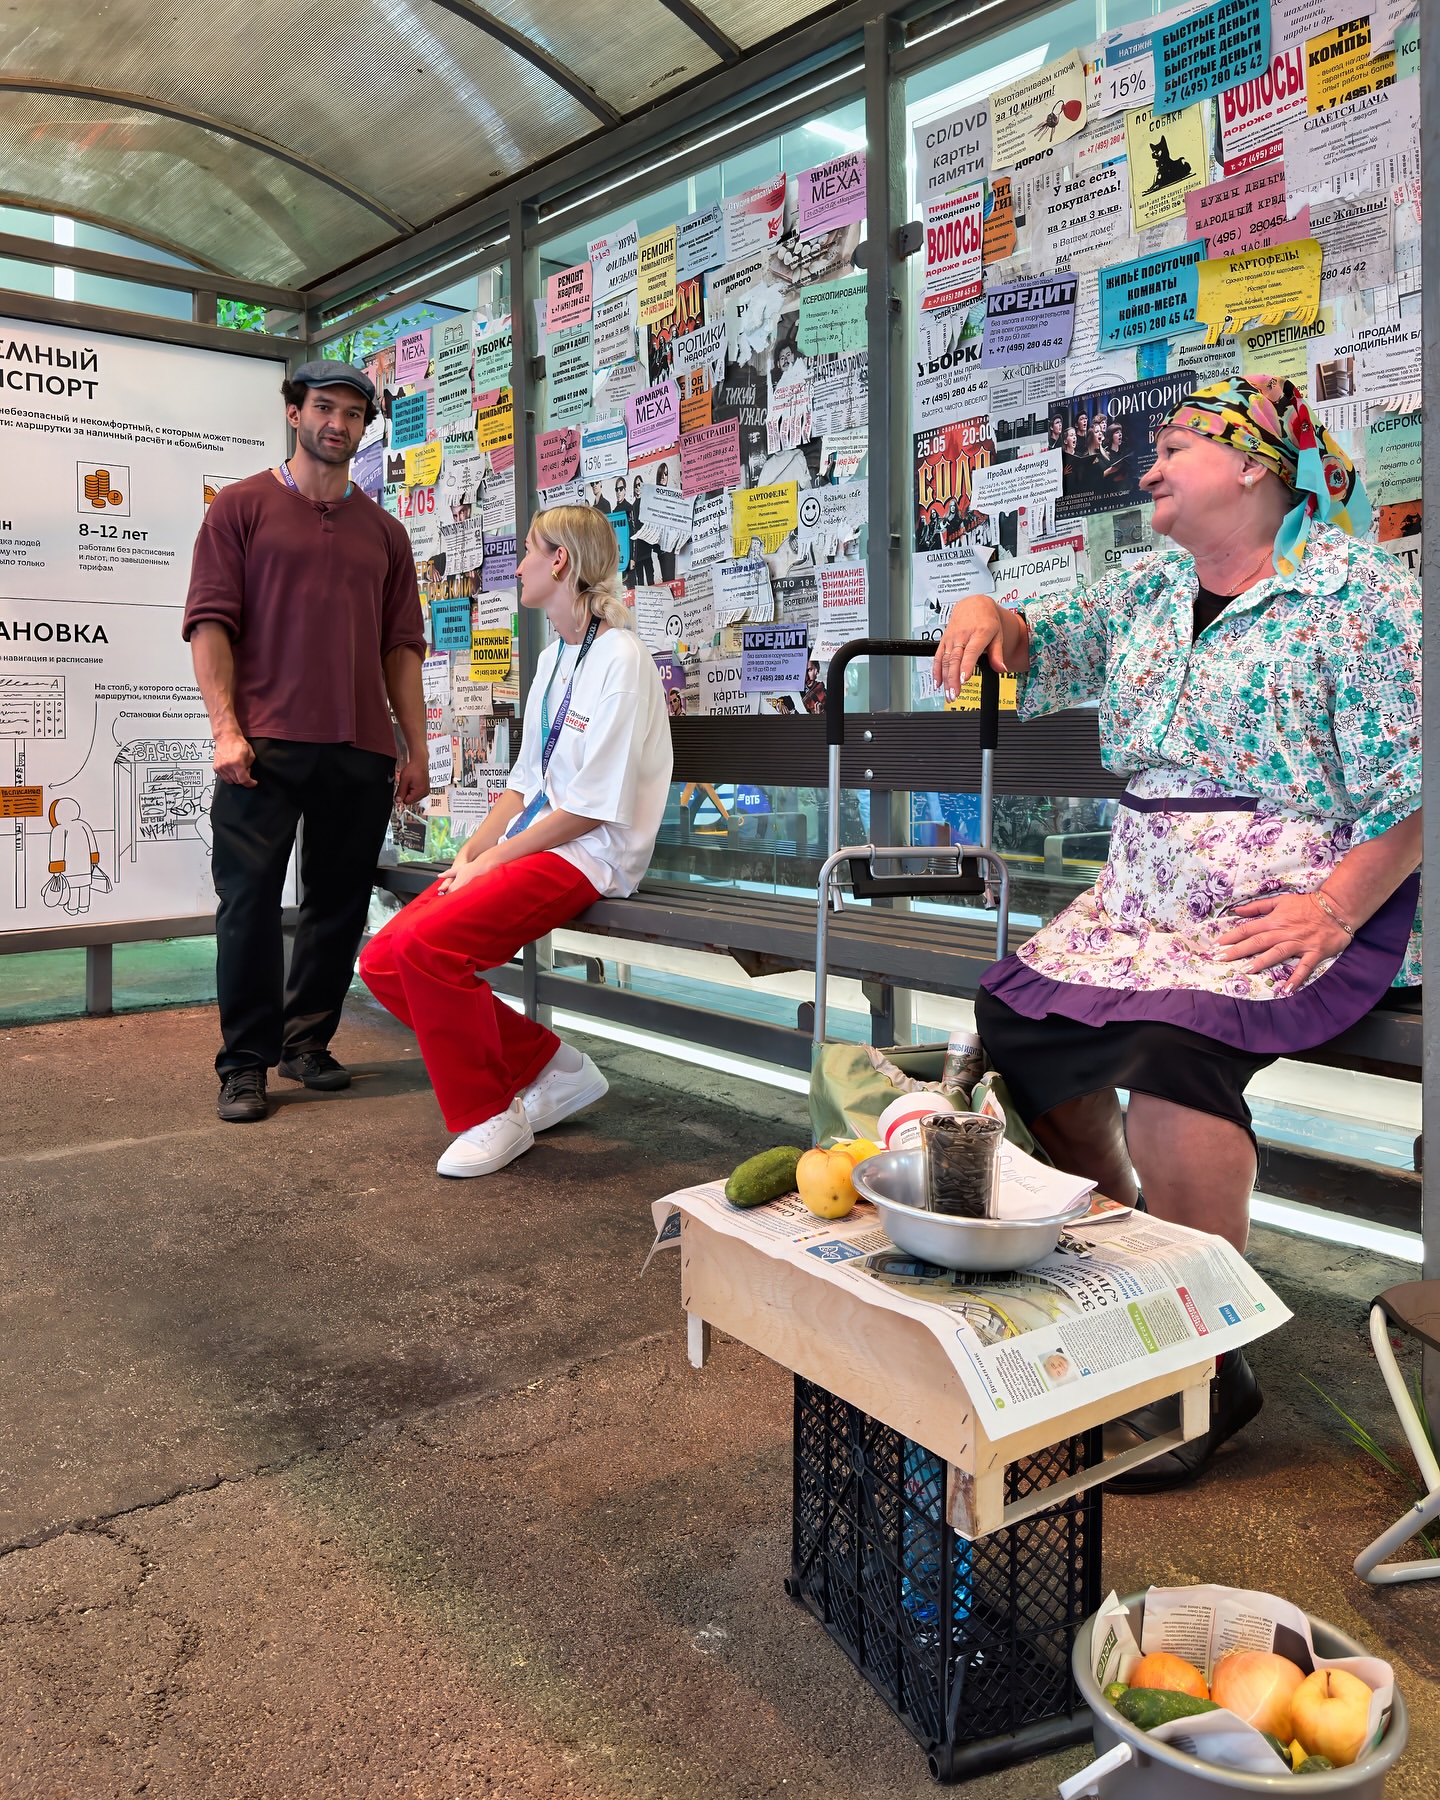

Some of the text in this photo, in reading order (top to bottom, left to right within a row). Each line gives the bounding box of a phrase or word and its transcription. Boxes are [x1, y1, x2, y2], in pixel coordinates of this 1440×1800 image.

[1163, 12, 1214, 46] БЫСТРЫЕ
[1164, 28, 1214, 61] БЫСТРЫЕ
[1218, 7, 1259, 38] ДЕНЬГИ
[1283, 22, 1312, 41] нарды
[1321, 15, 1334, 26] др.
[1164, 23, 1260, 77] БЫСТРЫЕ ДЕНЬГИ
[1165, 39, 1261, 92] БЫСТРЫЕ ДЕНЬГИ
[1322, 67, 1354, 84] гарантия
[994, 62, 1075, 108] Изготавливаем ключи
[1110, 70, 1146, 99] 15%
[1164, 54, 1262, 104] +7 (495) 280 45 42
[1224, 47, 1304, 124] ВОЛОСЫ
[1323, 61, 1394, 94] опыт работы более
[995, 86, 1055, 122] за 10 минут!
[1304, 92, 1388, 132] СДАЕТСЯ ДАЧА
[1224, 96, 1308, 138] дороже всех
[926, 111, 987, 148] CD/DVD
[934, 140, 979, 168] карты
[810, 155, 858, 183] ЯРМАРКА
[928, 157, 984, 188] памяти
[812, 169, 860, 203] МЕХА
[1065, 170, 1116, 194] нас есть
[928, 191, 979, 214] ПРИНИМАЕМ
[1048, 181, 1121, 214] покупатель!
[1201, 189, 1240, 208] НУЖНЫ
[929, 202, 980, 223] ежедневно
[1070, 216, 1087, 226] или
[1090, 211, 1095, 219] 3
[1196, 202, 1252, 230] НАРОДНЫЙ
[1333, 197, 1388, 221] Жильцы!
[618, 232, 637, 250] ИГРЫ
[927, 212, 981, 265] ВОЛОСЫ
[1060, 232, 1088, 247] Вашем
[641, 238, 674, 262] РЕМОНТ
[641, 252, 674, 272] КОМПЬЮТЕРОВ
[926, 262, 960, 278] дороже
[1141, 252, 1200, 278] ПОСУТОЧНО
[1230, 250, 1299, 273] КАРТОФЕЛЬ!
[1321, 262, 1366, 280] 280 45 42
[558, 270, 584, 288] РЕМОНТ
[726, 276, 751, 294] ДОРОГО
[1128, 277, 1176, 301] КОМНАТЫ
[640, 289, 673, 307] ВЫЕЗД НА ДОМ
[988, 283, 1076, 314] КРЕДИТ
[1119, 293, 1187, 321] КОЙКО-МЕСТА
[1109, 308, 1194, 340] +7 (495) 280 45 42
[1248, 320, 1325, 349] ФОРТЕПИАНО
[1359, 324, 1401, 340] ПРОДАМ
[477, 335, 512, 357] УБОРКА
[677, 322, 726, 358] РОЛИКИ
[996, 338, 1063, 353] +7 (495) 280 45 42
[1334, 332, 1408, 356] ХОЛОДИЛЬНИК
[401, 344, 425, 362] МЕХА
[684, 342, 720, 364] недорого
[0, 368, 98, 400] СПОРТ
[916, 368, 963, 387] позвоните мы
[953, 374, 971, 383] минут
[636, 385, 669, 406] ЯРМАРКА
[932, 392, 949, 404] (495)
[952, 387, 965, 397] 280
[968, 384, 976, 392] 45
[636, 397, 671, 424] МЕХА
[16, 420, 72, 434] маршрутки
[74, 427, 84, 435] за
[86, 429, 133, 441] наличный
[135, 434, 165, 445] расчёт
[175, 439, 224, 452] «бомбилы»
[80, 417, 153, 434] некомфортный,
[162, 427, 201, 439] которым
[203, 432, 231, 442] может
[232, 436, 265, 447] повезти
[684, 422, 736, 447] РЕГИСТРАЦИЯ
[918, 422, 992, 458] 25.05 20:00
[585, 455, 601, 471] 15%
[987, 458, 1049, 480] Продам квартиру
[1380, 461, 1408, 471] печать
[749, 489, 788, 502] КАРТОФЕЛЬ!
[14, 538, 40, 547] людей
[122, 529, 148, 542] лет
[12, 549, 26, 557] что
[79, 543, 115, 553] работали
[132, 548, 175, 557] расписания
[86, 554, 107, 563] льгот,
[110, 556, 119, 564] по
[121, 557, 169, 566] завышенным
[18, 559, 45, 567] только
[79, 564, 113, 573] тарифам
[821, 568, 864, 581] ВНИМАНИЕ!
[822, 578, 865, 590] ВНИМАНИЕ!
[1040, 576, 1071, 587] карандаши
[823, 588, 866, 599] ВНИМАНИЕ!
[823, 597, 866, 609] ВНИМАНИЕ!
[0, 622, 109, 644] АНОВКА
[474, 636, 509, 646] НАТЯЖНЫЕ
[744, 630, 807, 649] КРЕДИТ
[4, 655, 47, 663] навигация
[56, 656, 103, 664] расписание
[474, 649, 509, 660] ПОТОЛКИ
[107, 684, 130, 692] столб,
[139, 685, 173, 693] которого
[745, 795, 760, 805] ВТБ
